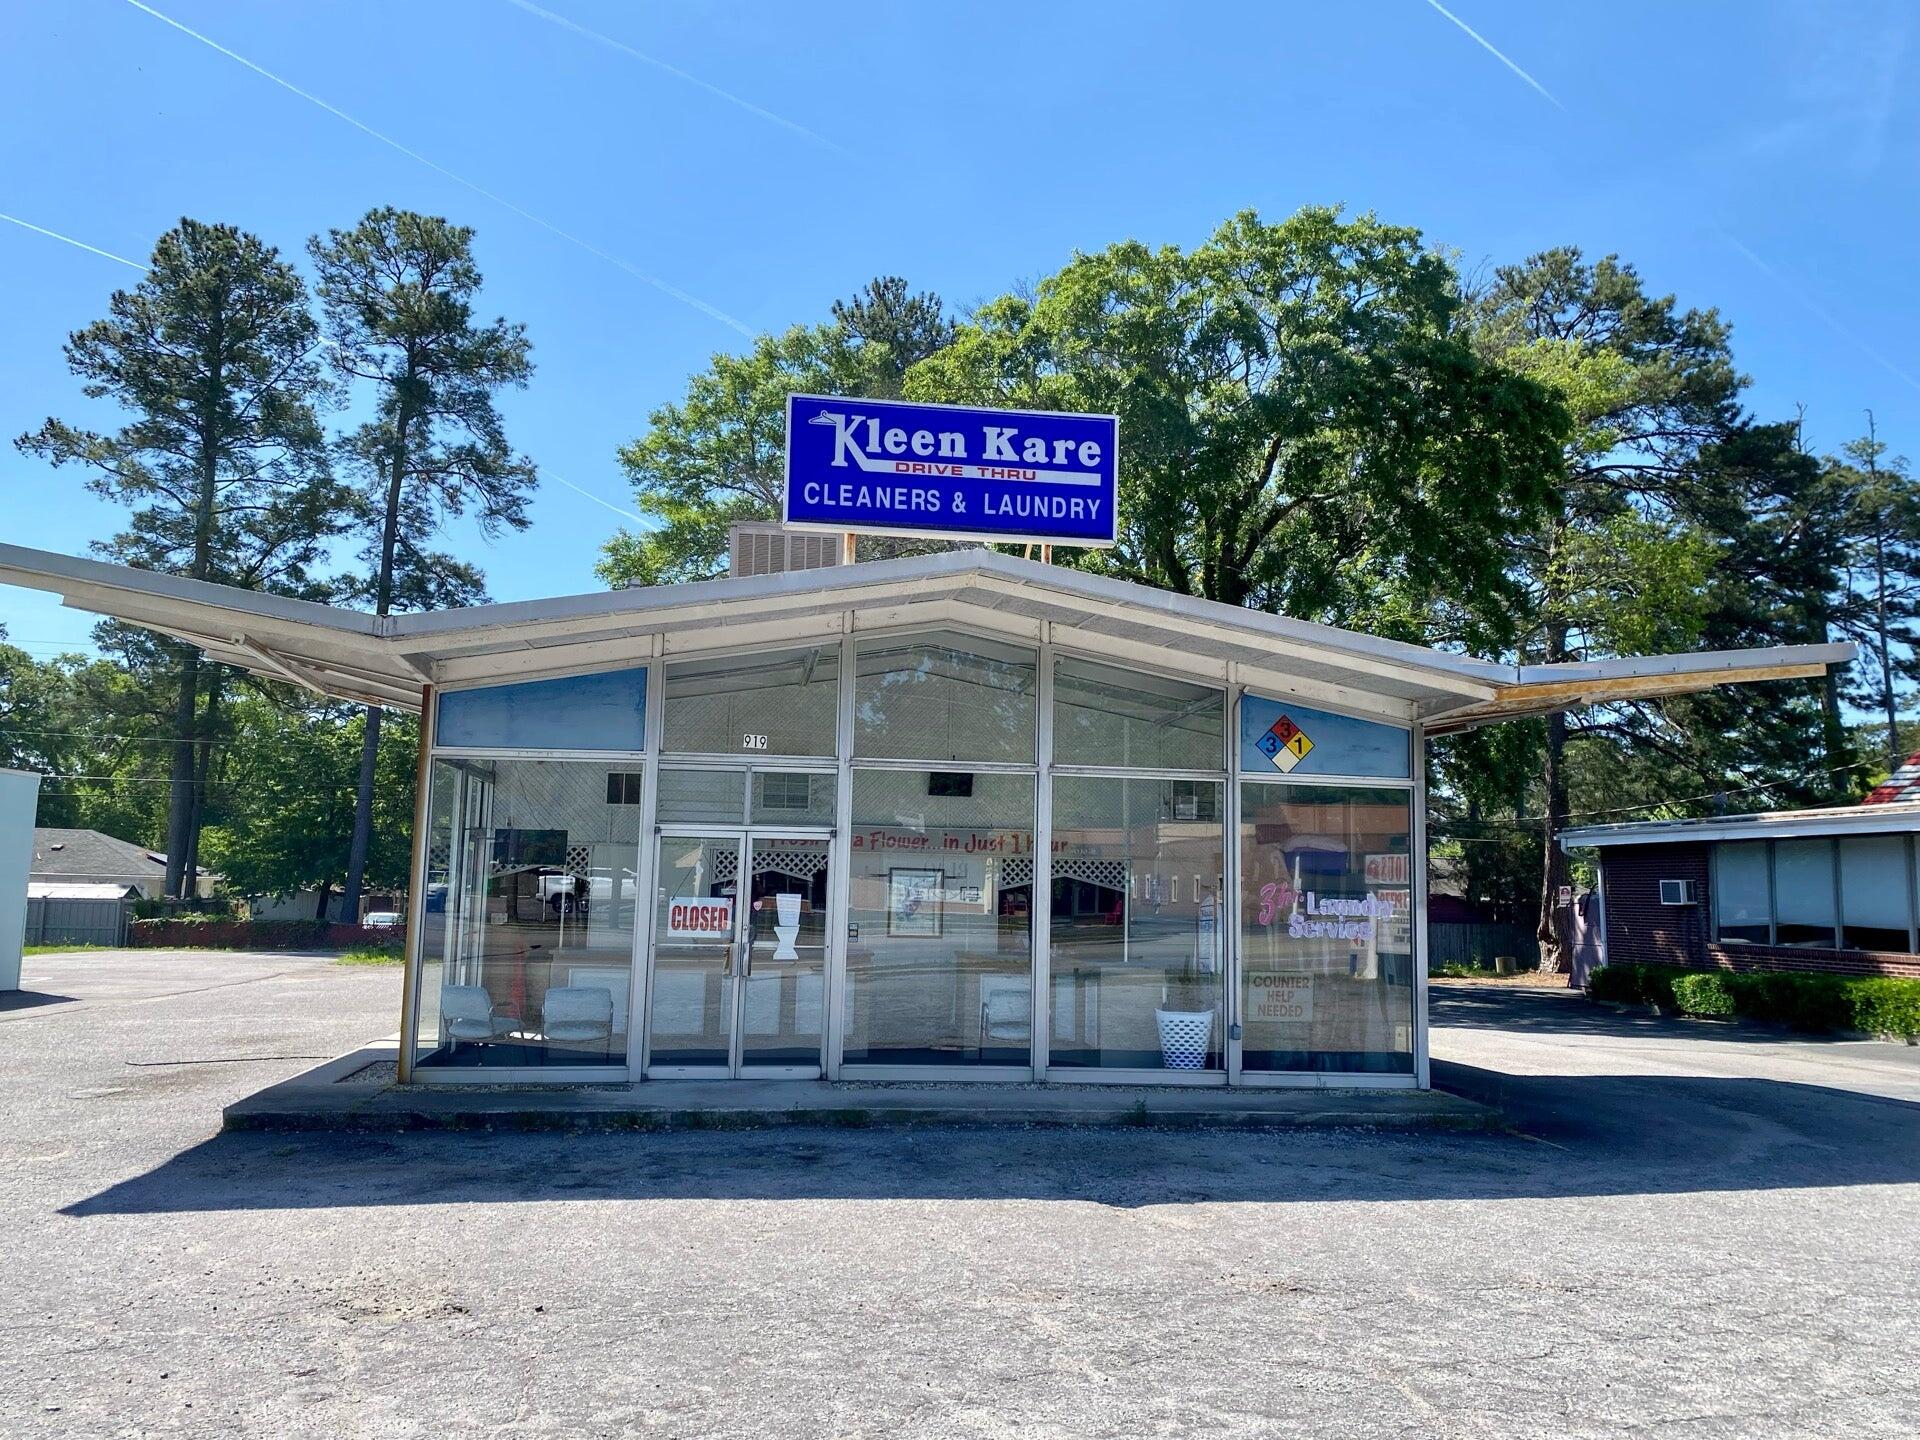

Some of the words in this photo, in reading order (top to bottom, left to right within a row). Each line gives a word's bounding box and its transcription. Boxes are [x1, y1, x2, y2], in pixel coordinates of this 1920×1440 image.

[827, 413, 967, 467] Kleen
[982, 426, 1101, 467] Kare
[895, 461, 963, 477] DRIVE
[977, 467, 1036, 481] THRU
[804, 482, 940, 512] CLEANERS
[952, 491, 967, 513] &
[984, 493, 1100, 520] LAUNDRY
[1280, 722, 1291, 739] 3
[744, 735, 767, 748] 919
[1265, 736, 1277, 753] 3
[1294, 736, 1303, 755] 1
[853, 834, 864, 848] a
[964, 833, 1006, 854] Just
[1011, 832, 1022, 855] 1
[1258, 882, 1276, 925] 3
[1306, 890, 1394, 921] Laundry
[671, 905, 729, 932] CLOSED
[1288, 912, 1376, 939] Service
[1253, 975, 1309, 989] COUNTER
[1267, 990, 1295, 1003] HELP
[1257, 1004, 1303, 1018] NEEDED
